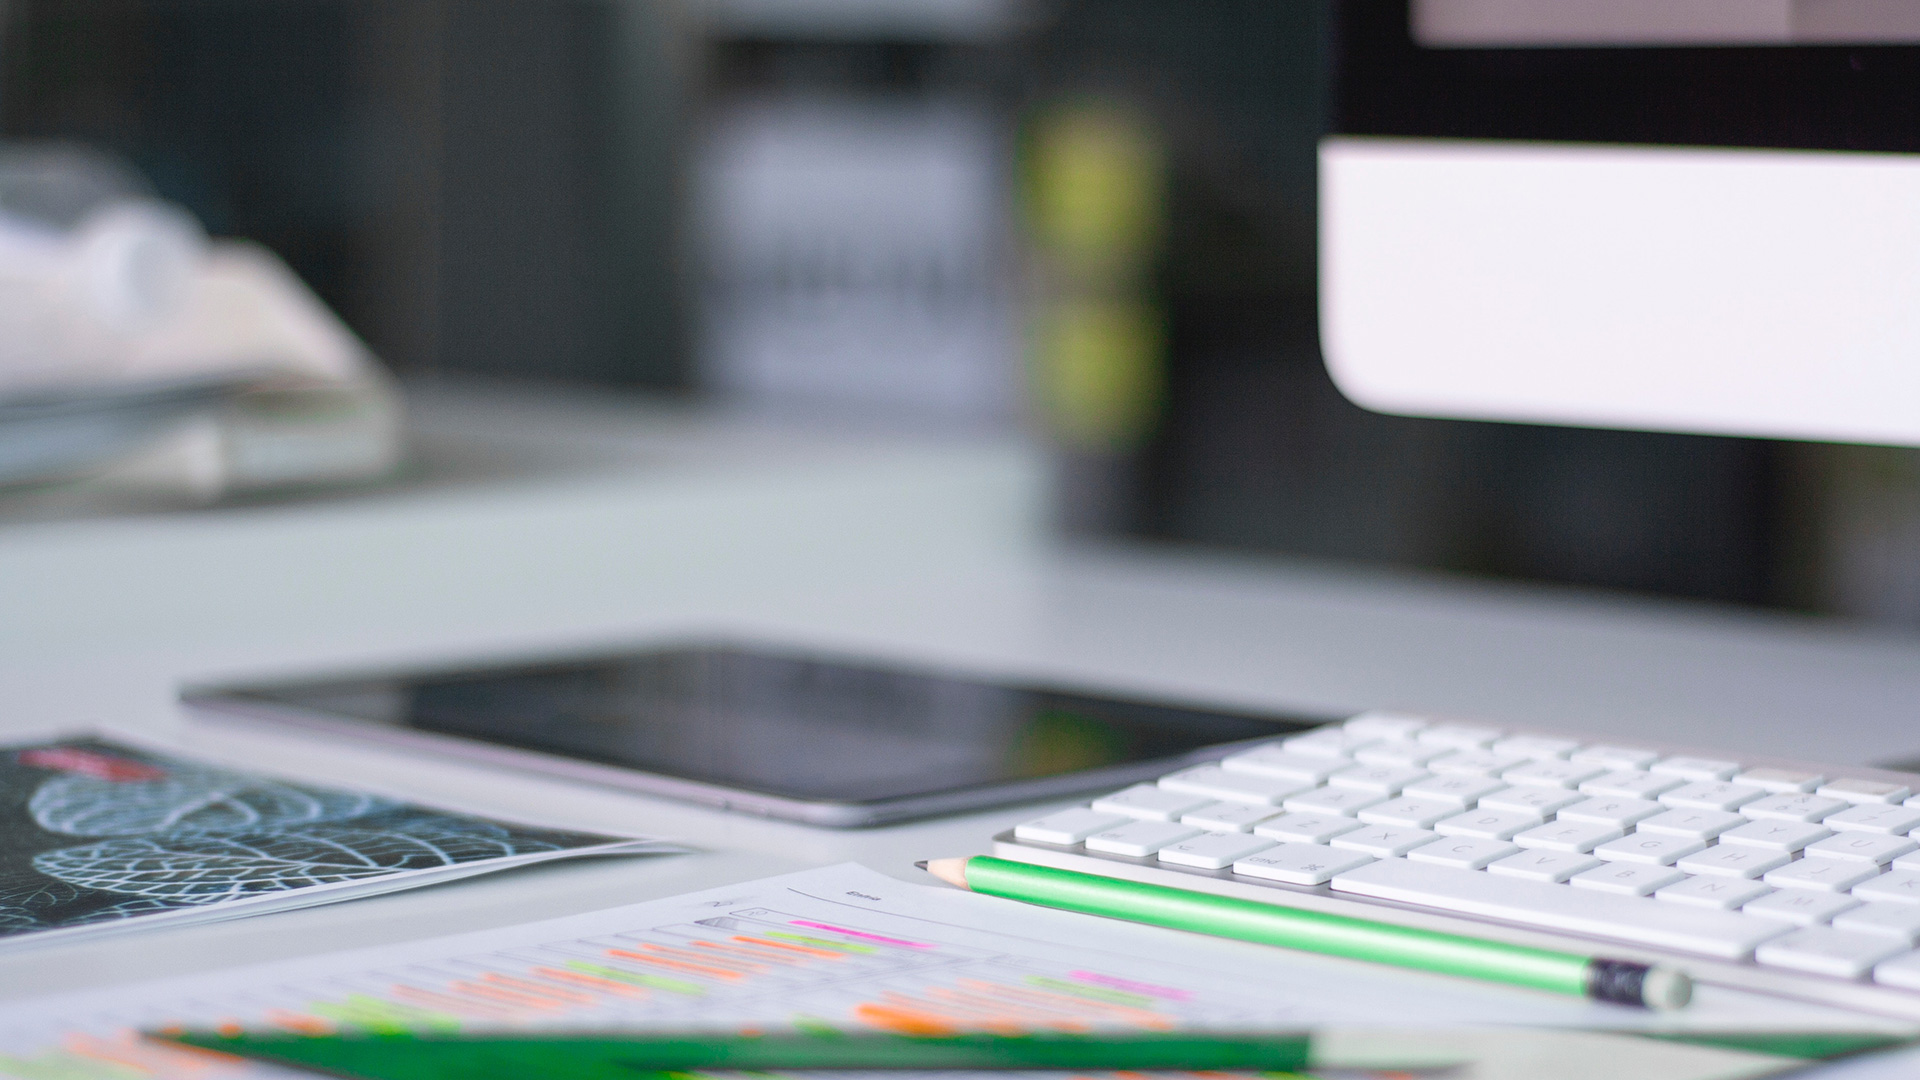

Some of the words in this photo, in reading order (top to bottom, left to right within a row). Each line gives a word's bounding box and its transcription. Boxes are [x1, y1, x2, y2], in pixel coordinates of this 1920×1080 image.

[1400, 804, 1420, 812] S
[1599, 803, 1619, 812] R
[1296, 819, 1320, 828] Z
[1477, 816, 1498, 825] D
[1683, 815, 1702, 823] T
[1557, 828, 1579, 836] F
[1768, 826, 1788, 834] Y
[1371, 831, 1398, 840] X
[1640, 840, 1662, 849] G
[1849, 839, 1874, 848] U
[1452, 844, 1473, 854] C
[1249, 856, 1283, 865] cmd
[1535, 855, 1557, 865] V
[1721, 852, 1748, 862] H
[1615, 869, 1636, 879] B
[1700, 882, 1727, 893] N
[1898, 879, 1920, 889] K
[1786, 896, 1815, 906] M
